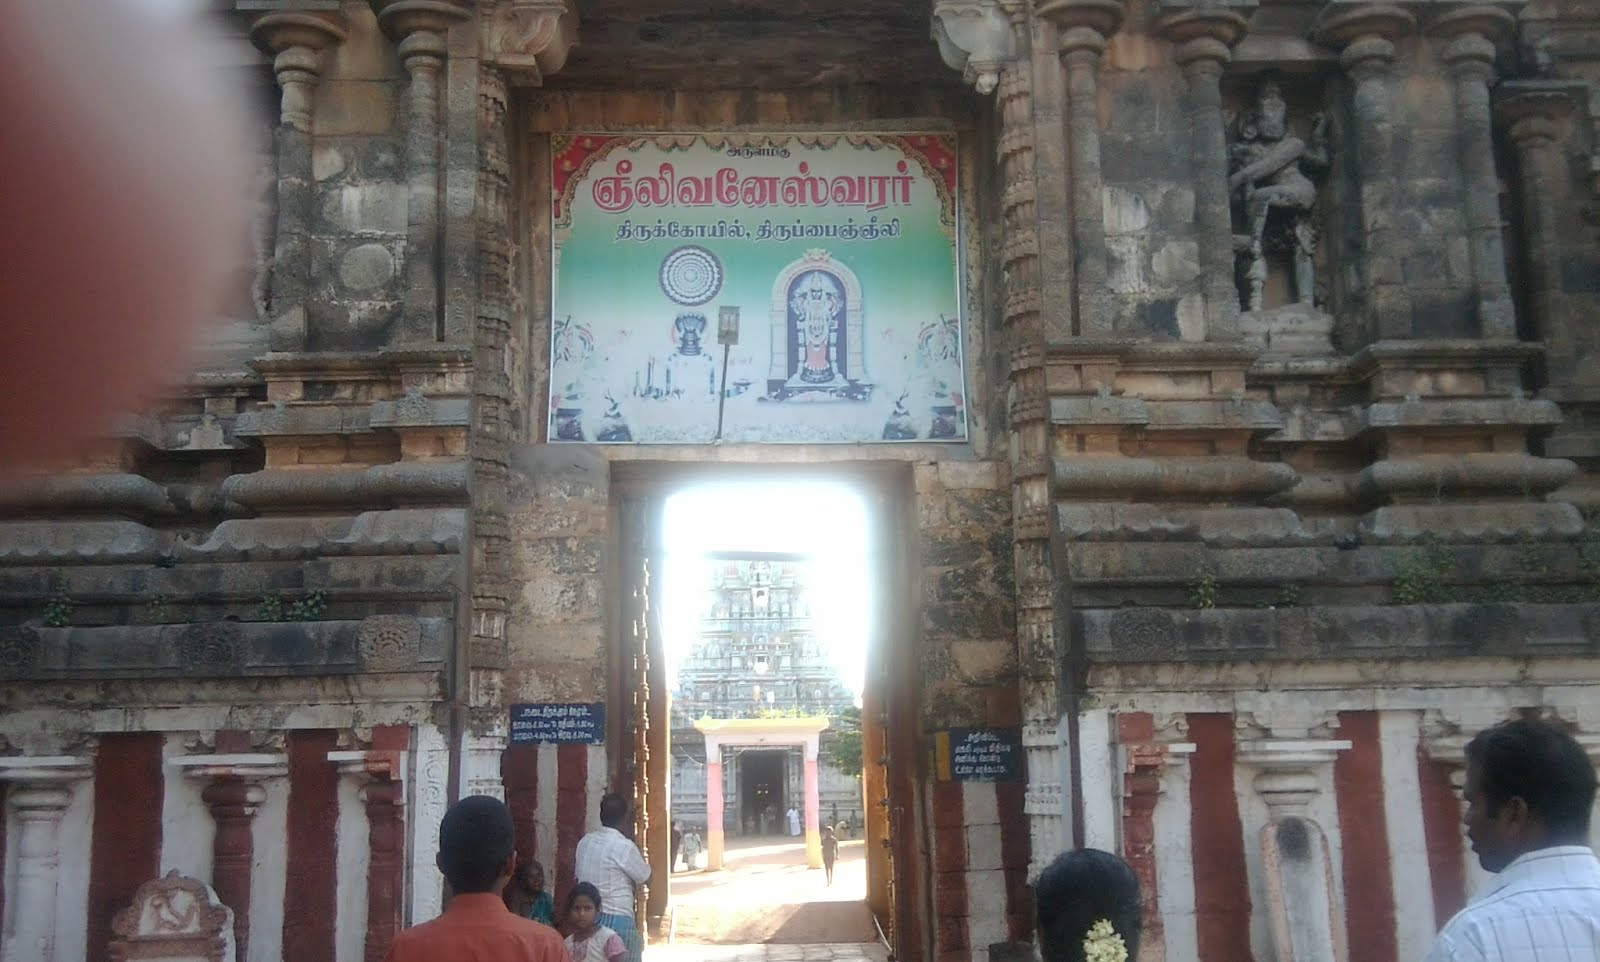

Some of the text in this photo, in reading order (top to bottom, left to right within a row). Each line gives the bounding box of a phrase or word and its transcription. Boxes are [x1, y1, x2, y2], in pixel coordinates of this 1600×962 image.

[726, 146, 791, 159] அருள்மிகு
[592, 159, 915, 213] ஞீலிவனேஸ்வரர்
[615, 216, 901, 241] திருக்கோயில், திருப்பைஞ்ஞீலி
